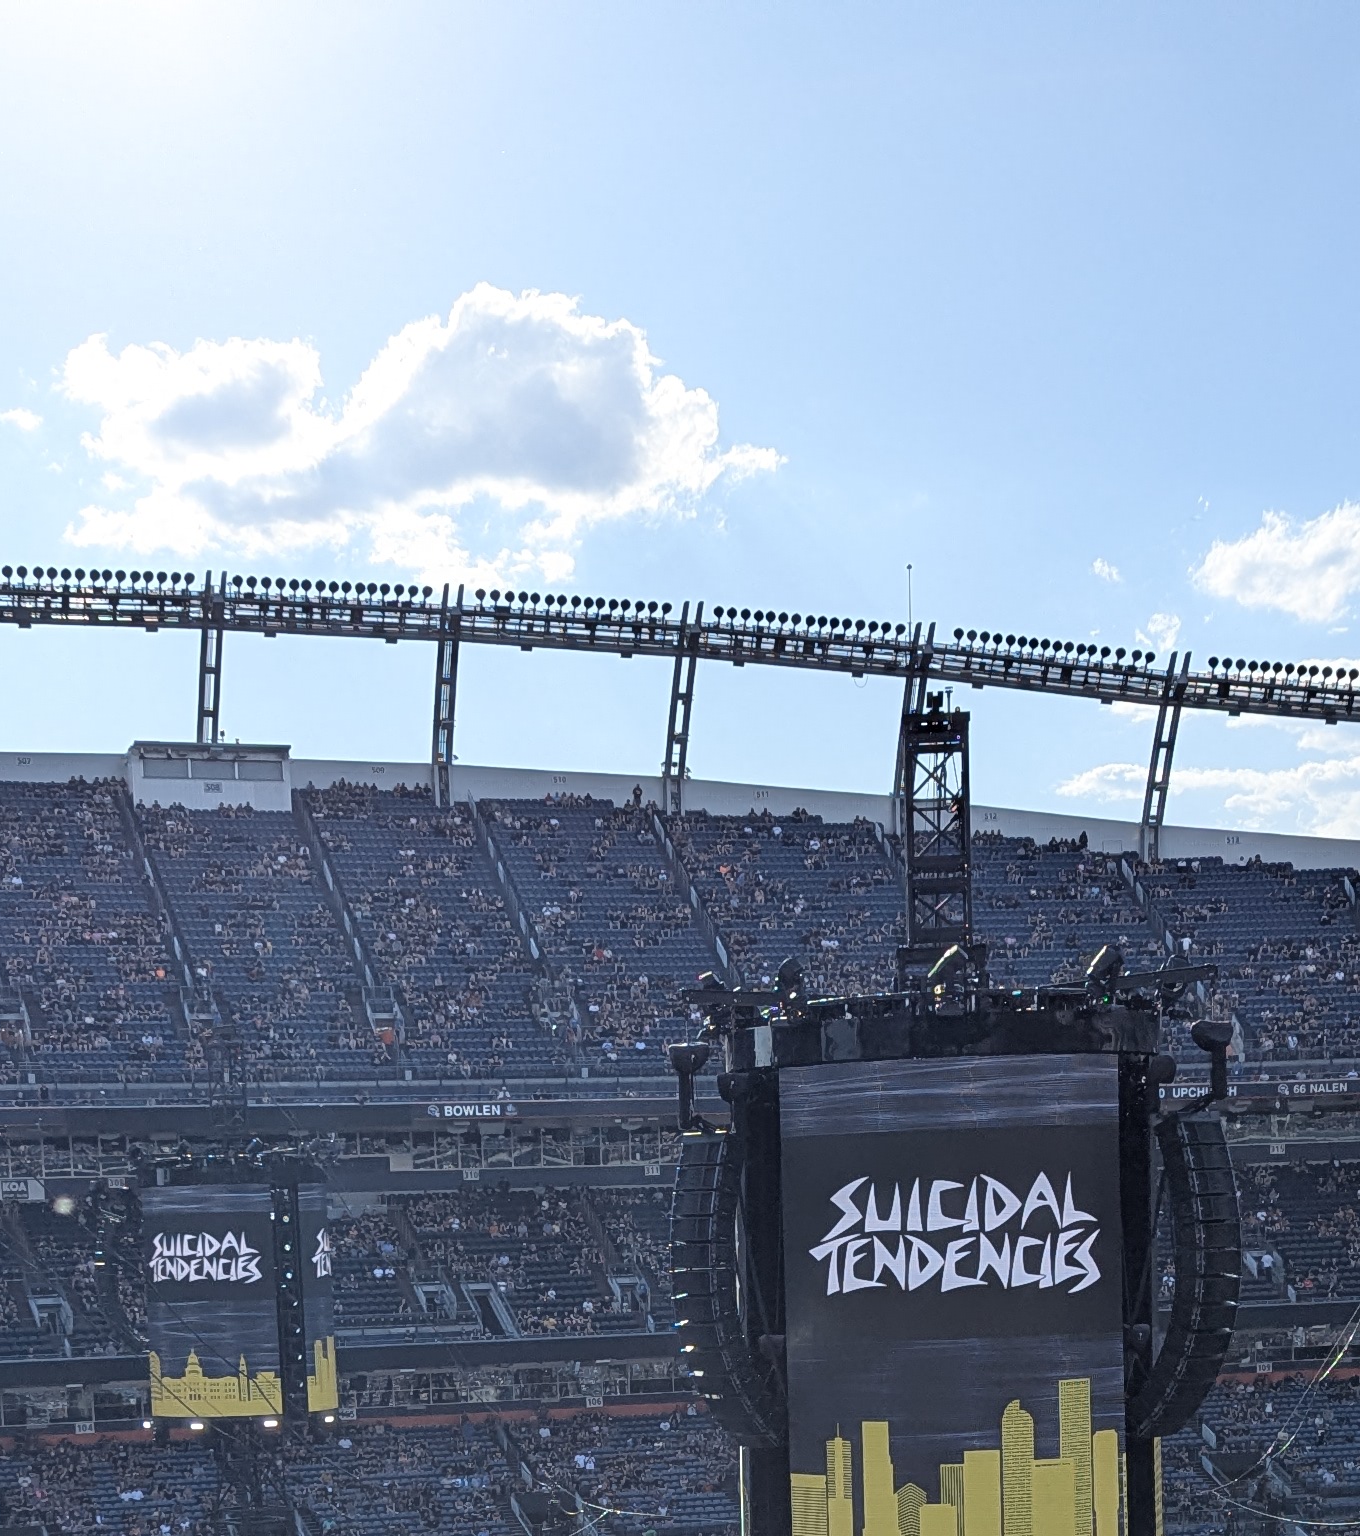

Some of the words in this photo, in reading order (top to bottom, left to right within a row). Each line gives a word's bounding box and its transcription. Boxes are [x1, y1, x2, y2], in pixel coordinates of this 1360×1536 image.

[1293, 1083, 1306, 1094] 66
[1309, 1083, 1348, 1094] NALEN
[443, 1104, 501, 1117] BOWLEN
[3, 1182, 27, 1191] KOA
[819, 1170, 1099, 1242] SUICIDAL
[151, 1230, 260, 1260] SUICIDAL
[808, 1227, 1102, 1297] TENDENCIES
[148, 1255, 263, 1284] TENDENCIES
[588, 1398, 601, 1406] 106
[77, 1424, 93, 1432] 104
